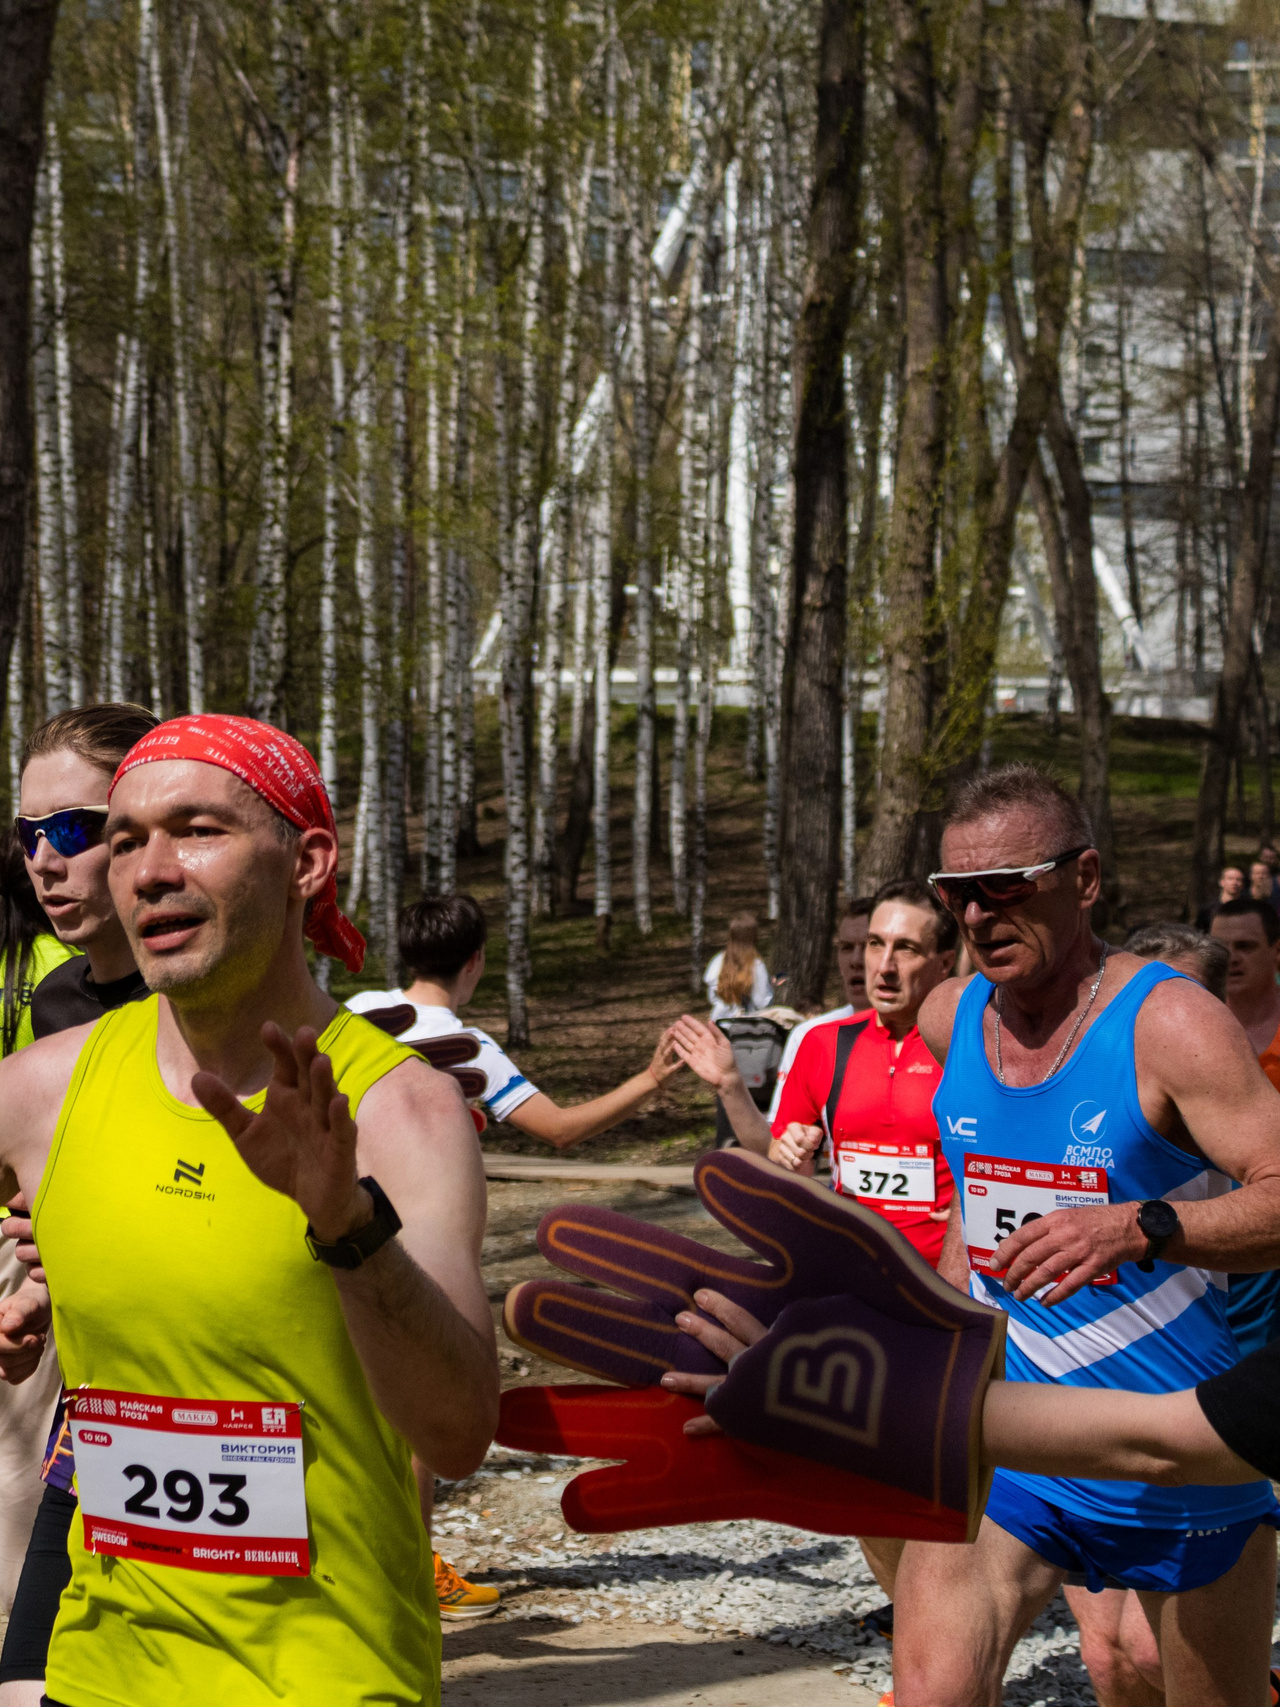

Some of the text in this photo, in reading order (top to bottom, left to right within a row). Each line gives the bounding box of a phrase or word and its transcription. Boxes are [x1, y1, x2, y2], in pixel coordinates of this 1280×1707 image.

[222, 728, 266, 759] МЕЧТЕ
[1066, 1145, 1113, 1159] ВСМПО
[994, 1164, 1021, 1173] МАЙСКАЯ
[1061, 1156, 1115, 1169] АВИСМА
[994, 1170, 1012, 1178] ГРОЗА
[859, 1169, 910, 1196] 372
[156, 1184, 215, 1202] NORDSKI
[1055, 1194, 1105, 1204] ВИКТОРИЯ
[120, 1401, 163, 1414] МАЙСКАЯ
[120, 1410, 149, 1421] ГРОЗА
[177, 1412, 213, 1423] MAKFA
[83, 1433, 93, 1442] 10
[221, 1444, 296, 1455] ВИКТОРИЯ
[122, 1464, 250, 1527] 293
[244, 1550, 298, 1564] BERGAUER
